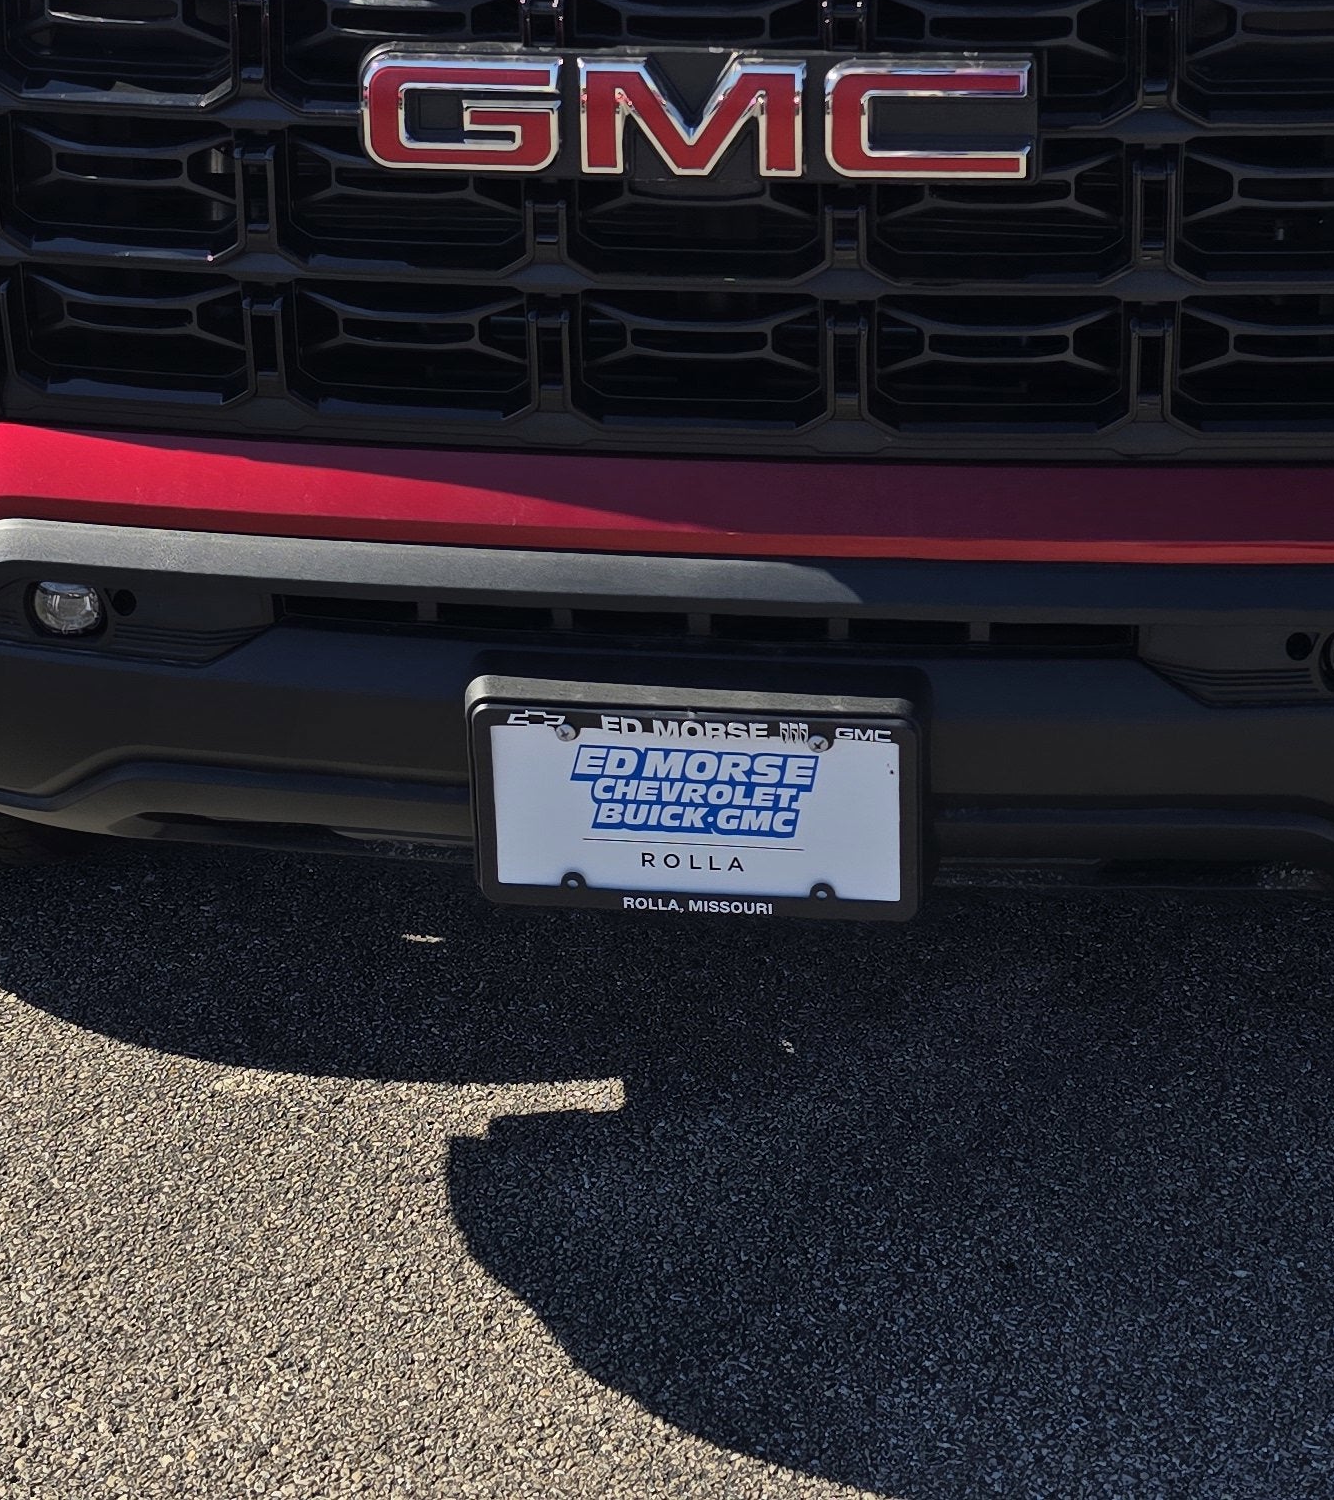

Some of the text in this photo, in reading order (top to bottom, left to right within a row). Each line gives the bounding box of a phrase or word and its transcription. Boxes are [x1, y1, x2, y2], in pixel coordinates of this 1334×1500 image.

[361, 47, 1033, 179] GMC
[601, 715, 770, 740] ED MORSE
[835, 727, 892, 743] GMC
[574, 746, 816, 786] ED MORSE
[593, 778, 798, 808] CHEVROLET
[640, 852, 745, 872] ROLLA
[623, 896, 774, 915] ROLLA, MISSOURI
